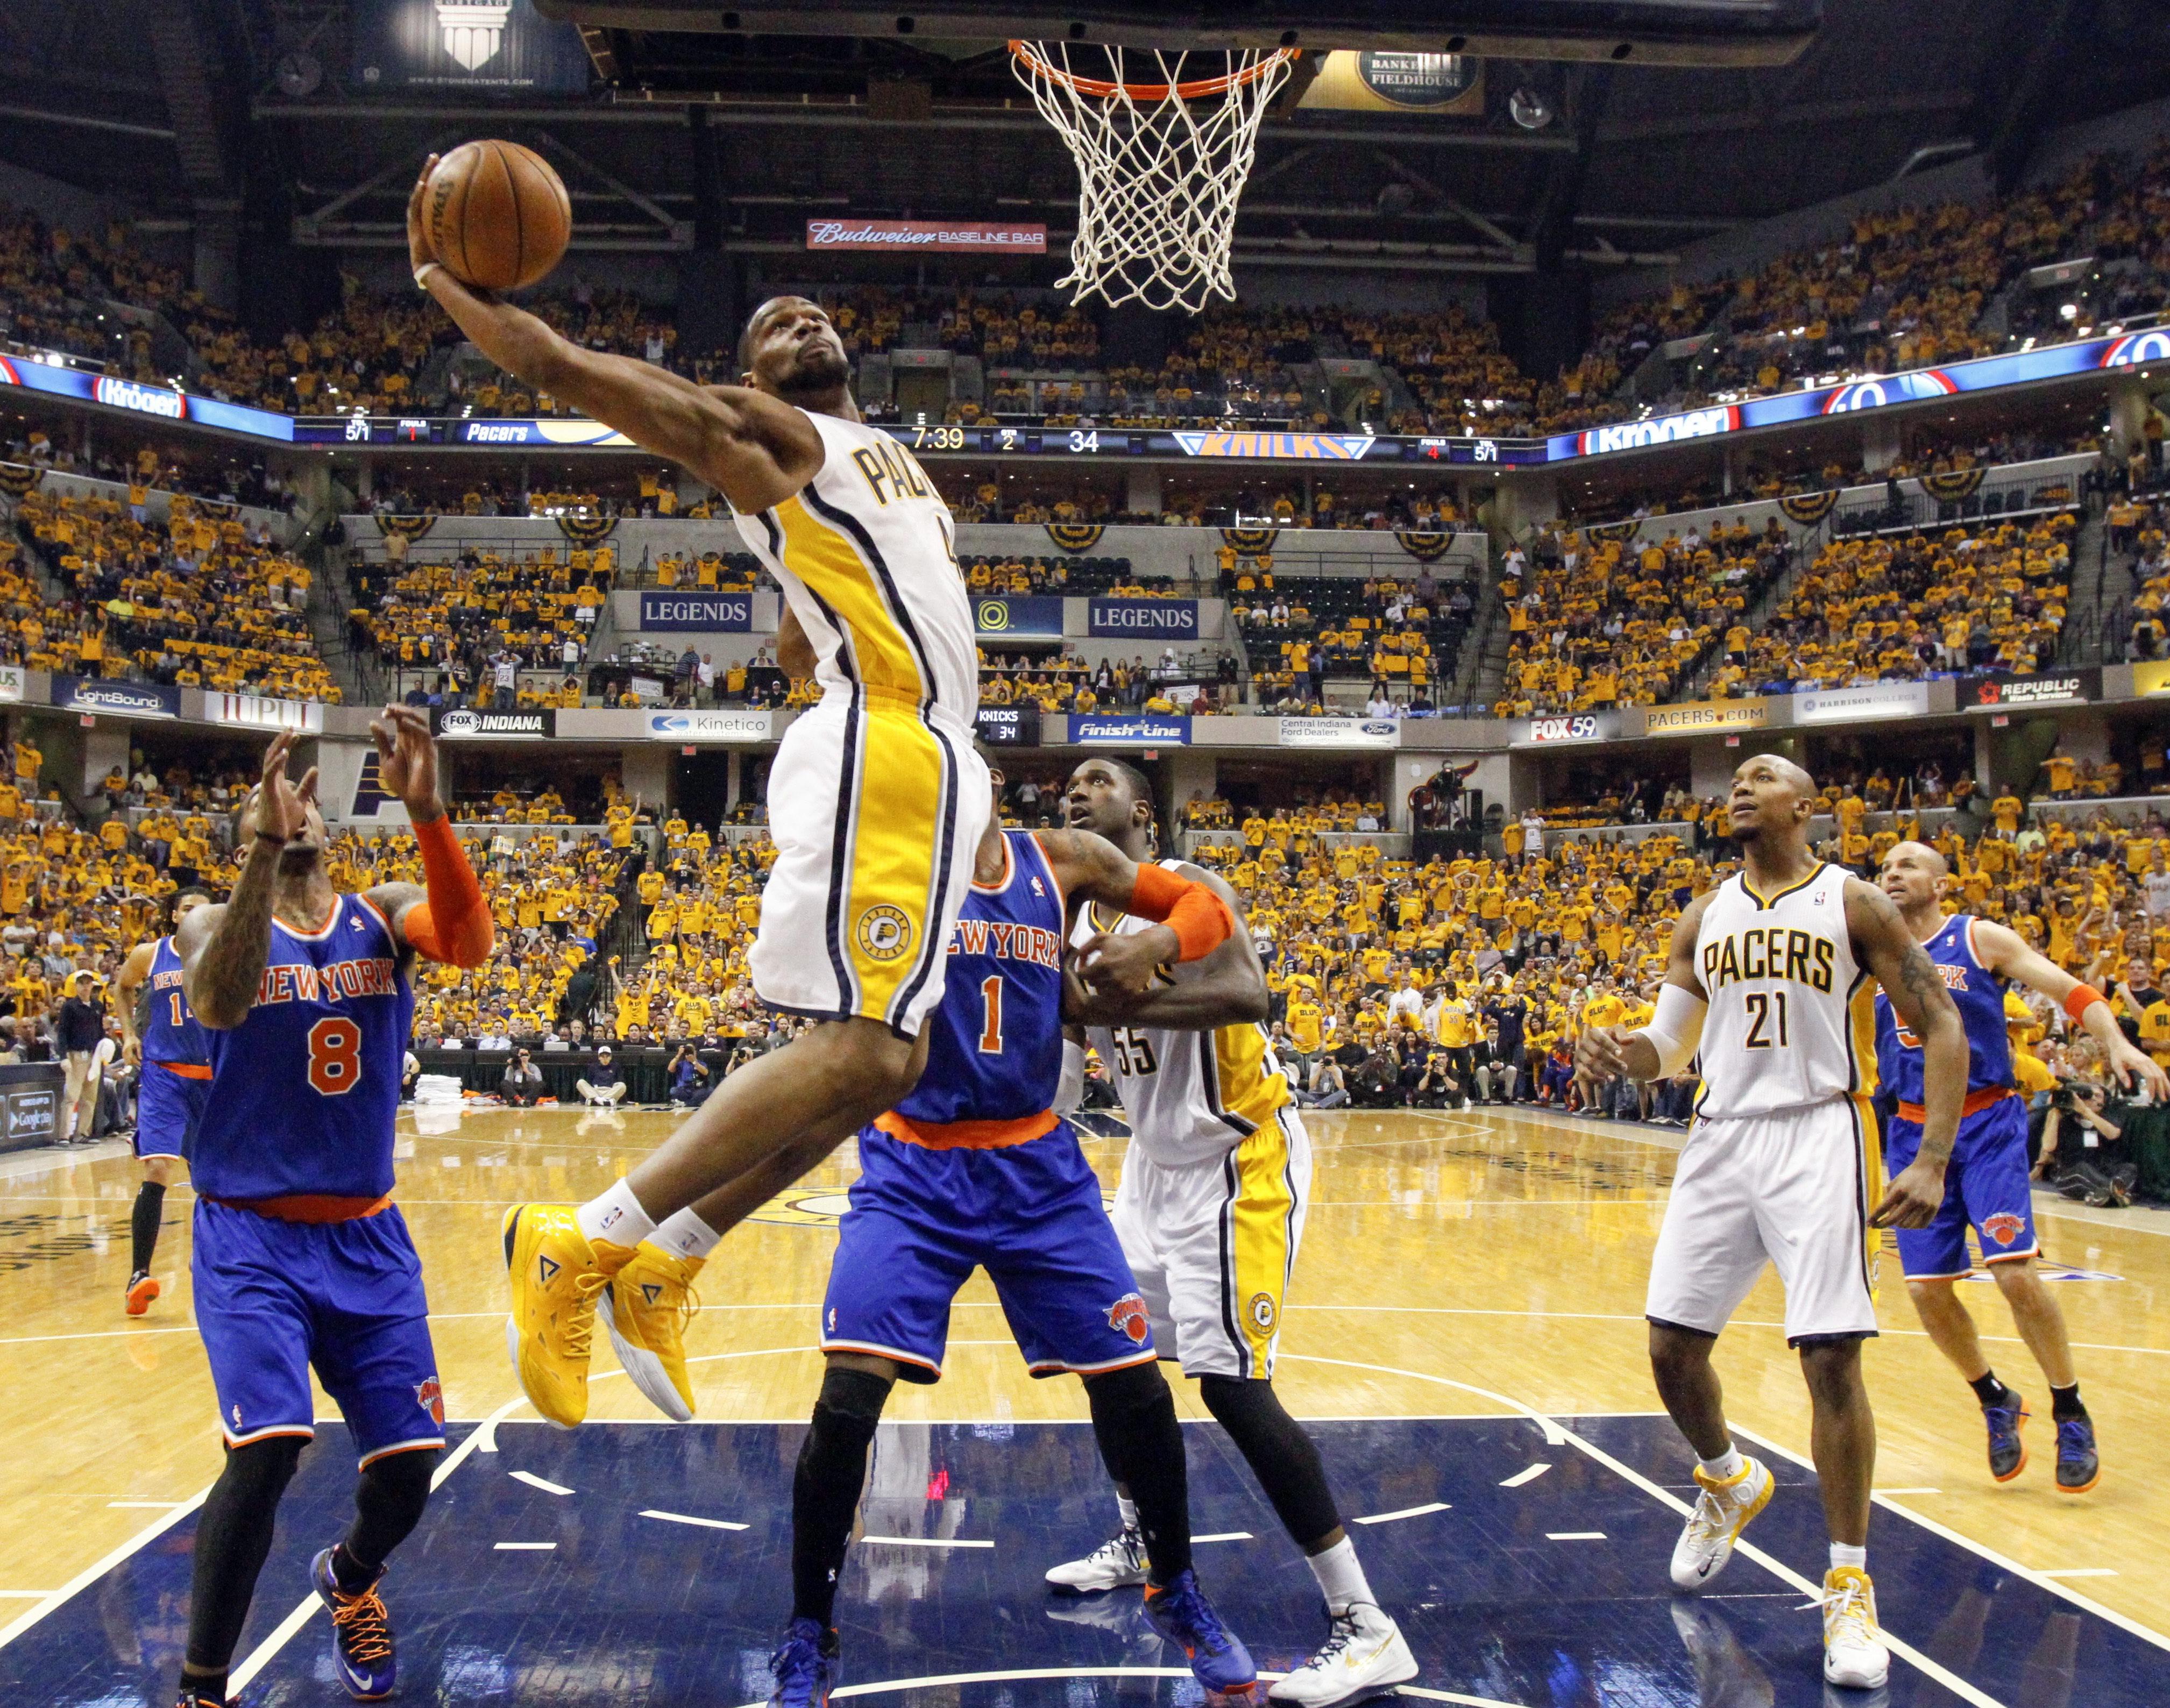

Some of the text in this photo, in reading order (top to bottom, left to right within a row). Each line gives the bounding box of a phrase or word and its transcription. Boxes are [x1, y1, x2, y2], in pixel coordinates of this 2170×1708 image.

[1372, 74, 1461, 87] FIELDHOUSE
[809, 223, 1044, 244] Budweiser BASELINE BAR
[346, 426, 370, 441] 5/1
[409, 427, 416, 440] 1
[467, 423, 528, 440] Pacers
[912, 427, 963, 449] 7:39
[1003, 436, 1013, 450] 2
[1069, 430, 1099, 452] 34
[1428, 446, 1438, 459] 4
[1474, 446, 1498, 461] 5/1
[850, 439, 940, 508] PAC
[646, 602, 747, 621] LEGENDS
[1094, 608, 1194, 628] LEGENDS
[2001, 678, 2080, 695] REPUBLIC
[74, 687, 159, 708] LightBound
[1820, 693, 1918, 708] HARRISON COLLEGE
[2036, 691, 2073, 701] Services
[223, 694, 310, 729] IUPUI
[450, 715, 472, 725] FOX
[979, 710, 1019, 722] KNICKS
[698, 717, 765, 731] Kinetico
[999, 726, 1016, 739] 34
[1079, 723, 1134, 737] Finish
[1304, 728, 1339, 736] Dealers
[1317, 720, 1351, 728] Indiana
[1367, 723, 1389, 734] Ford
[1530, 716, 1597, 741] FOX 59
[990, 922, 1060, 973] YORK
[1703, 927, 1835, 1000] PACERS
[153, 970, 183, 990] NEW
[318, 958, 398, 1003] YORK
[978, 974, 1004, 1055] 1
[1744, 991, 1790, 1052] 21
[307, 1016, 361, 1096] 8
[1111, 1026, 1157, 1077] 55
